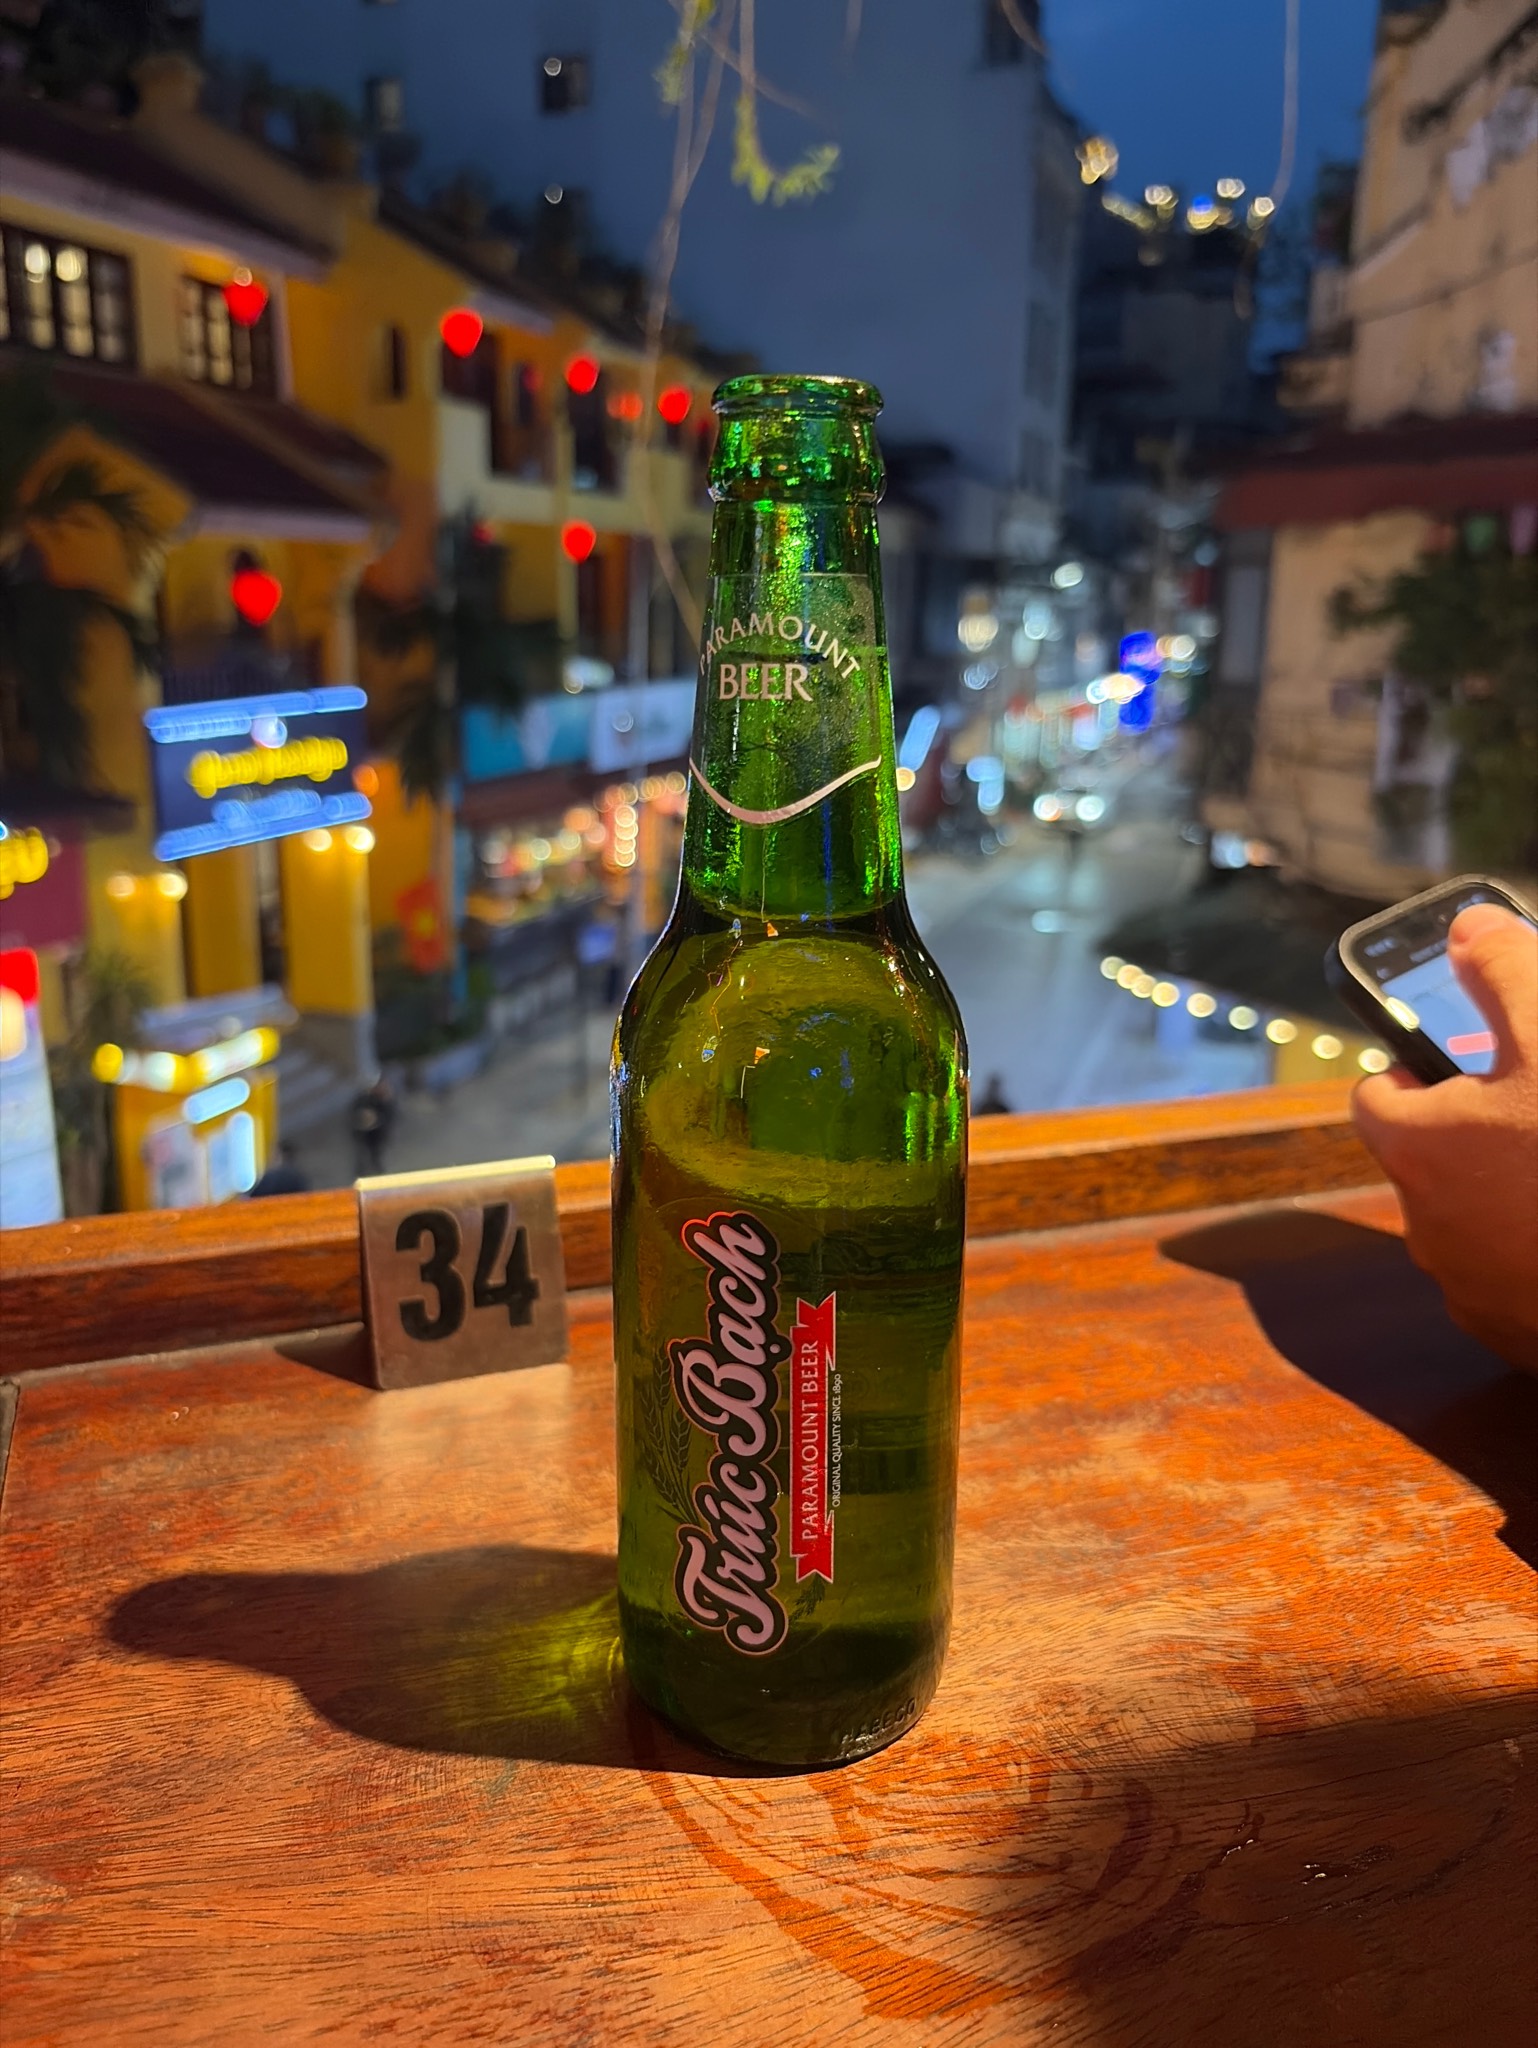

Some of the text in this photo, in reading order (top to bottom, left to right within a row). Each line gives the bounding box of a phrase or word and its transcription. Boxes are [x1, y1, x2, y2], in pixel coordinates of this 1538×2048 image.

[700, 612, 860, 679] PARAMOUNT
[719, 663, 813, 701] BEER
[395, 1202, 540, 1342] 34
[677, 1220, 783, 1646] Trúc Bạch
[801, 1340, 819, 1541] PARAMOUNT BEER
[832, 1373, 844, 1508] ORIGINAL QUALITY SINCE 1890
